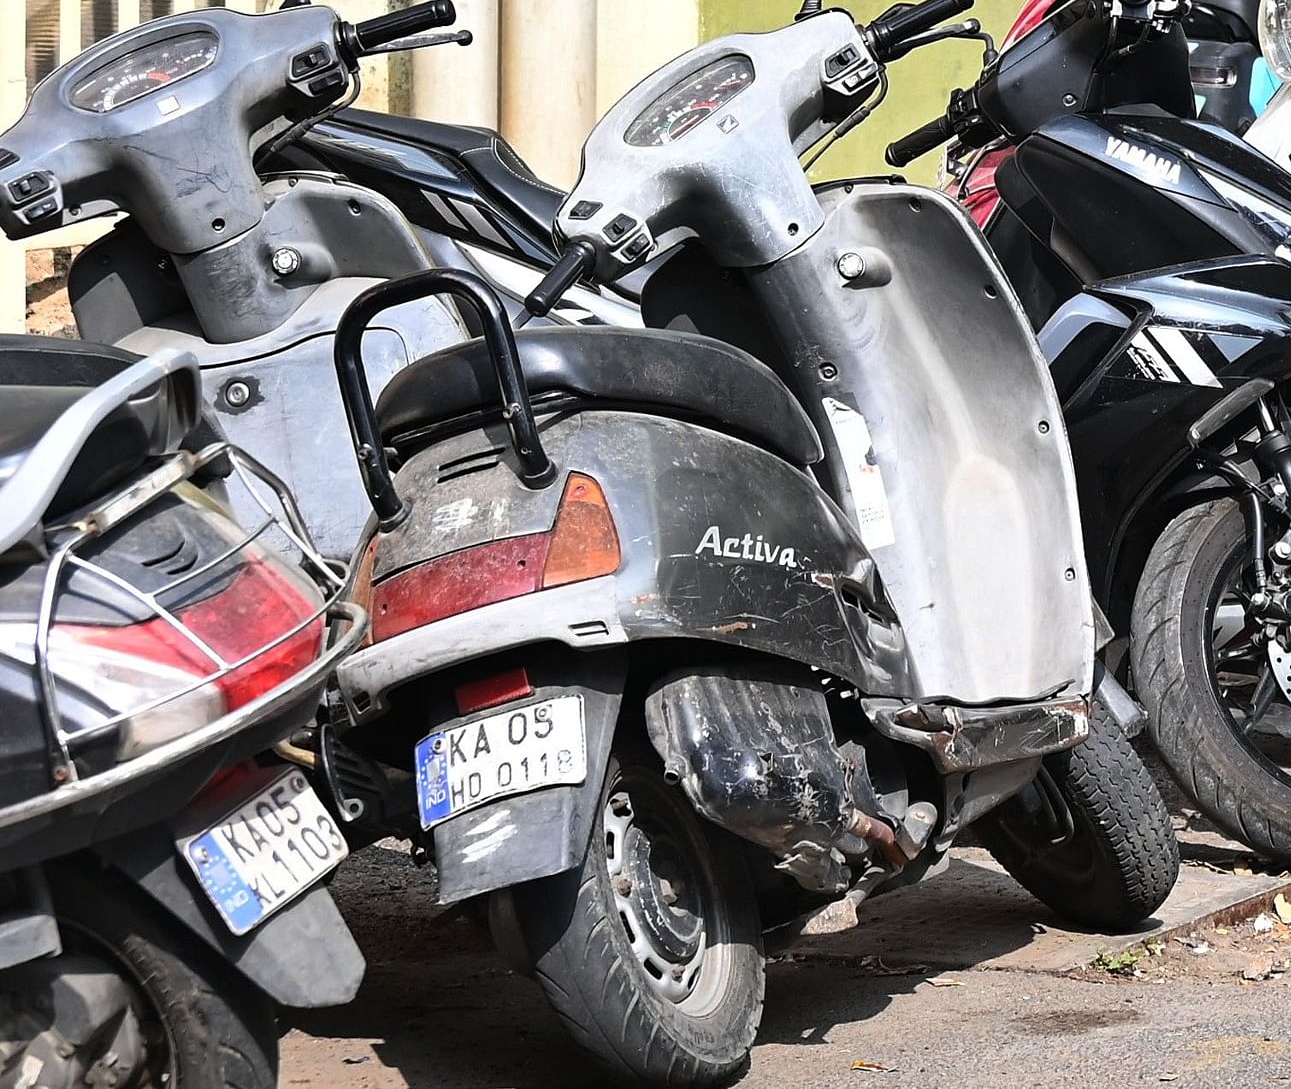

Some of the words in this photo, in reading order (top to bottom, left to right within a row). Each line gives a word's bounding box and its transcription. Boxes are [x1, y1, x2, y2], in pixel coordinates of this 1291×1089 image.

[1105, 136, 1181, 185] YAMAHA
[694, 524, 798, 568] Activa
[450, 722, 492, 768] KA
[425, 789, 447, 811] IND
